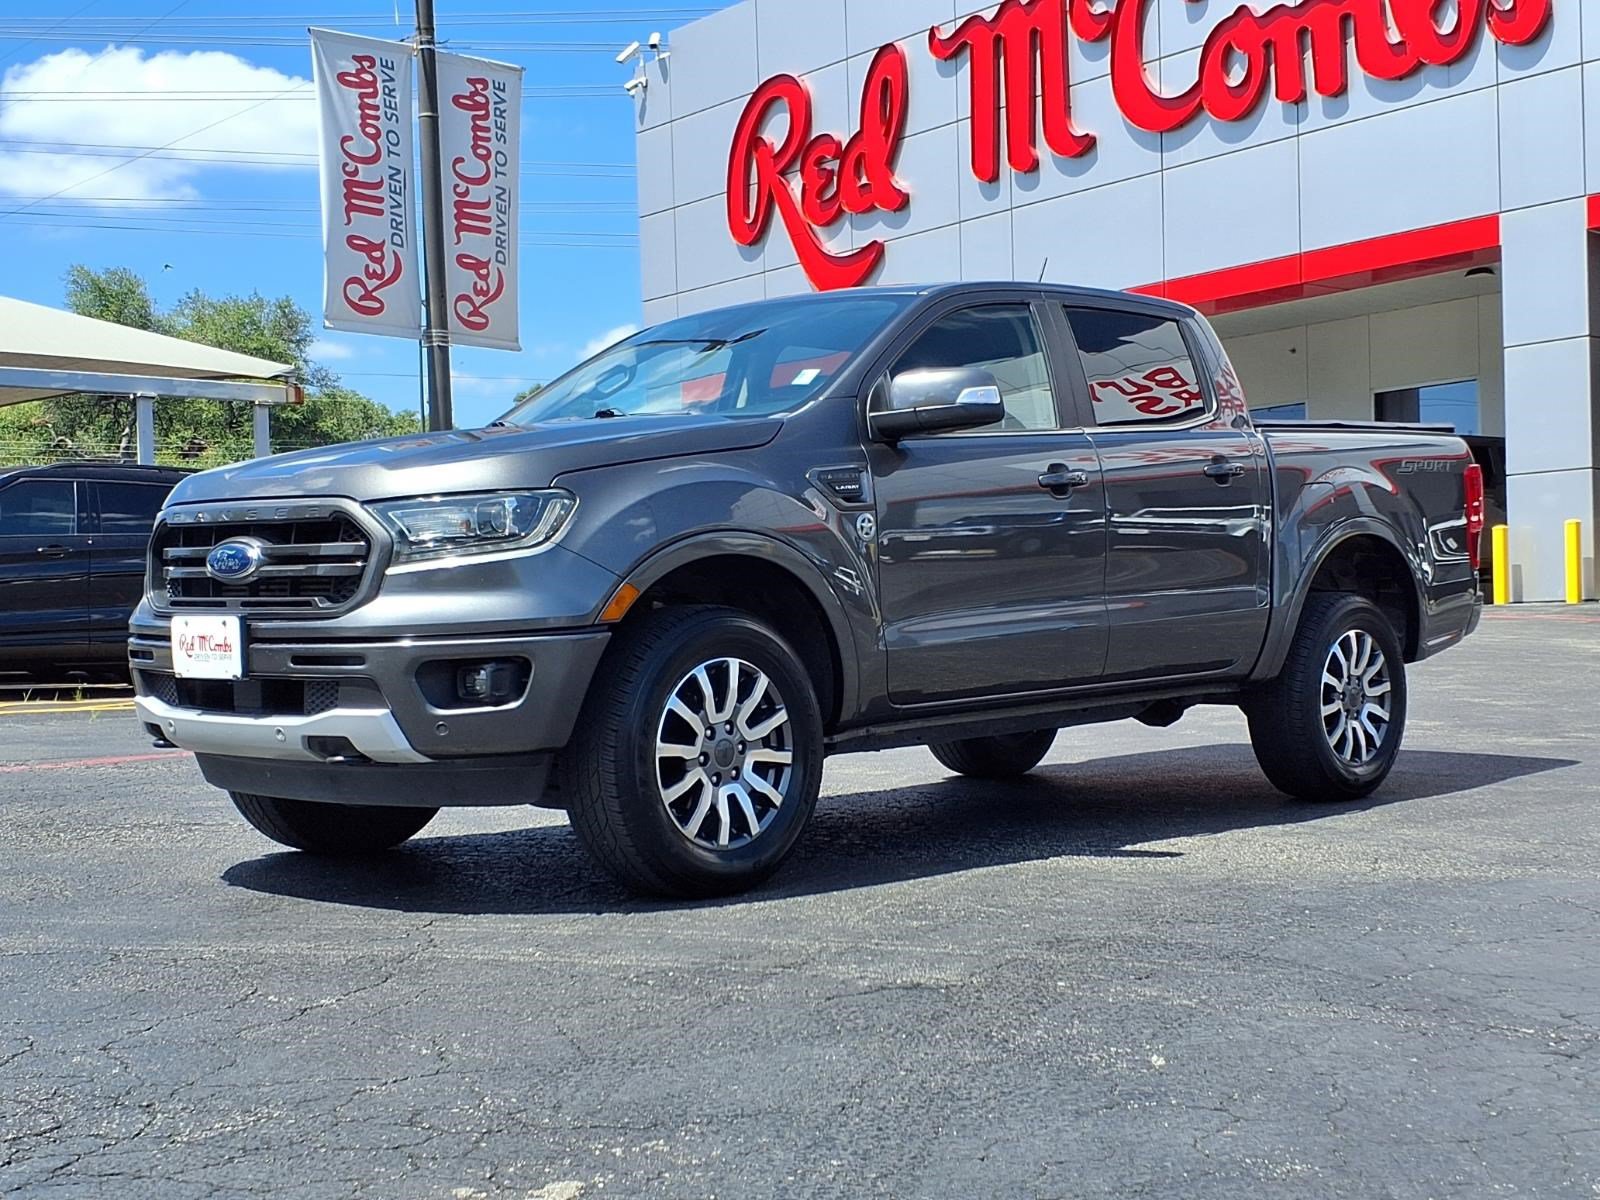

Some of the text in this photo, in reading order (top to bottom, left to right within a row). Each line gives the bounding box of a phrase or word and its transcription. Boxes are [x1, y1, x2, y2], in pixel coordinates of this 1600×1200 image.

[336, 54, 403, 316] Red McCombs
[380, 57, 405, 249] DRIVEN TO SERVE
[452, 77, 504, 331] Red McCombs
[492, 79, 508, 266] DRIVEN TO SERVE
[727, 42, 910, 291] Red
[173, 506, 321, 522] RANGER
[1397, 461, 1451, 474] SPORT
[179, 633, 194, 658] Red
